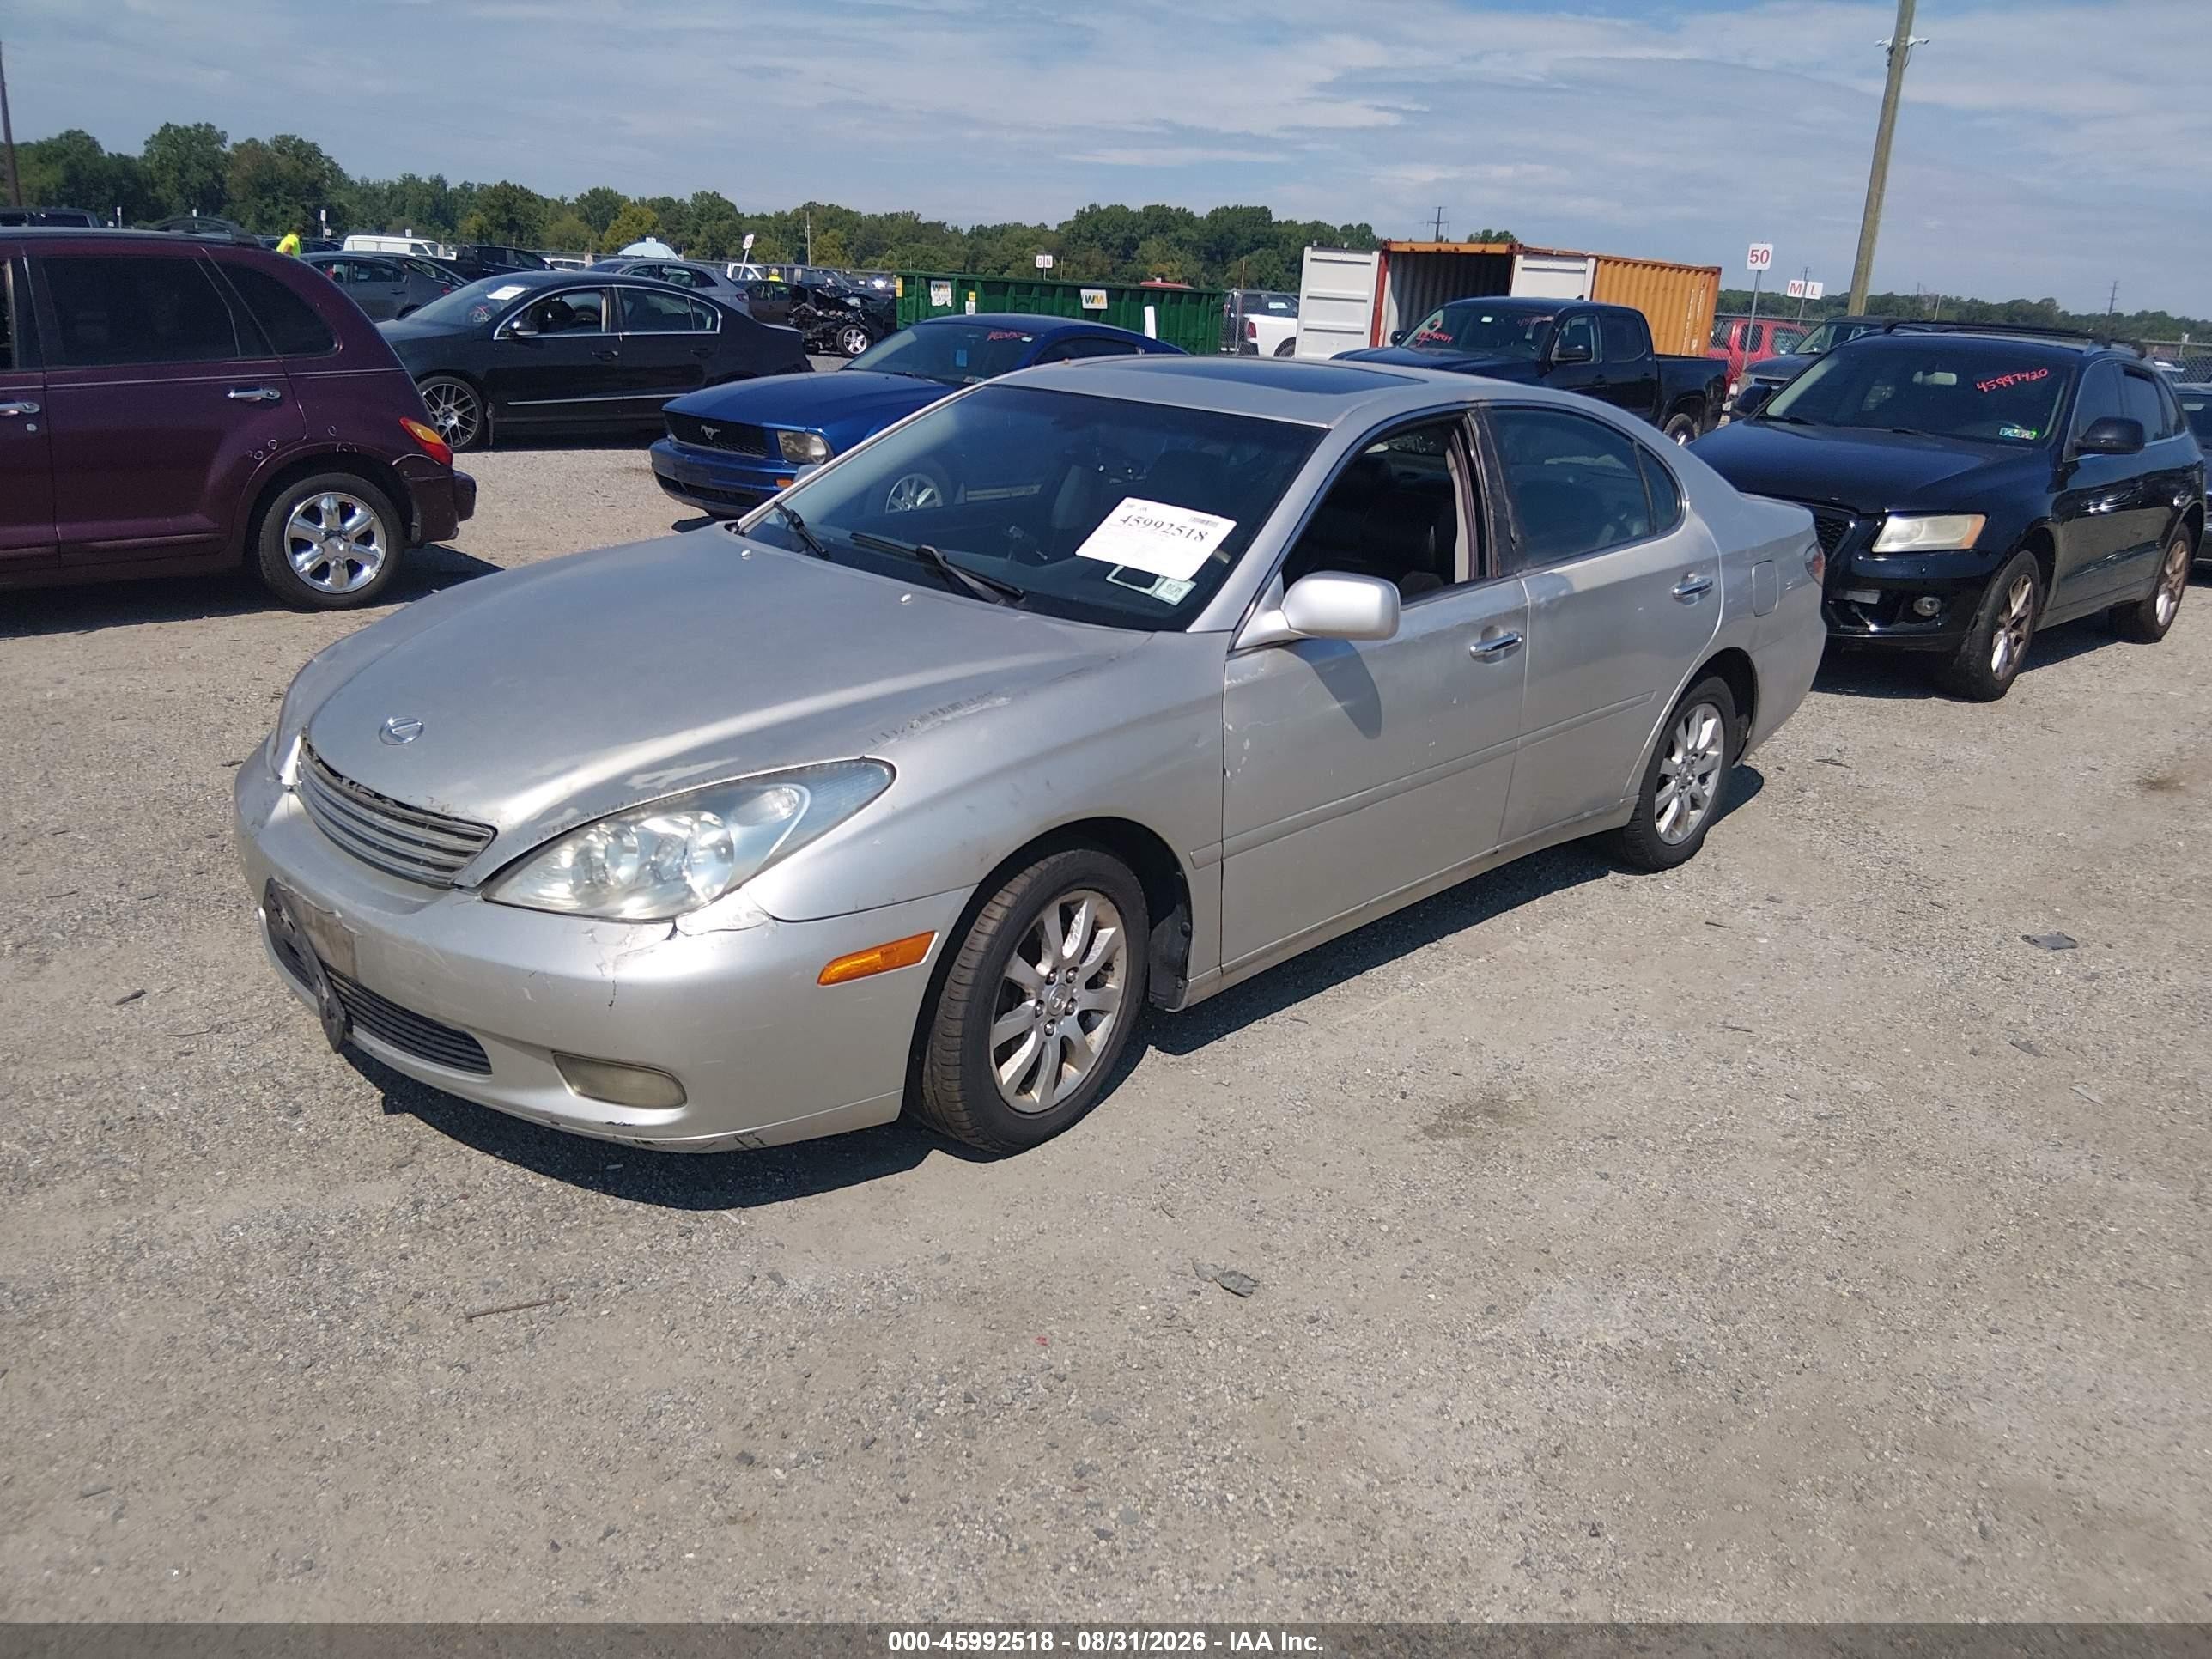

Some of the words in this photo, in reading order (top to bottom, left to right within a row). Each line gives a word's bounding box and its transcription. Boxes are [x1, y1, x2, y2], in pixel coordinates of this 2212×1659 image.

[1749, 249, 1770, 264] 50
[1790, 283, 1802, 295] M
[1810, 285, 1818, 296] L
[1085, 295, 1104, 305] WM
[1976, 368, 2048, 392] 45997420
[1120, 514, 1209, 543] 45992518
